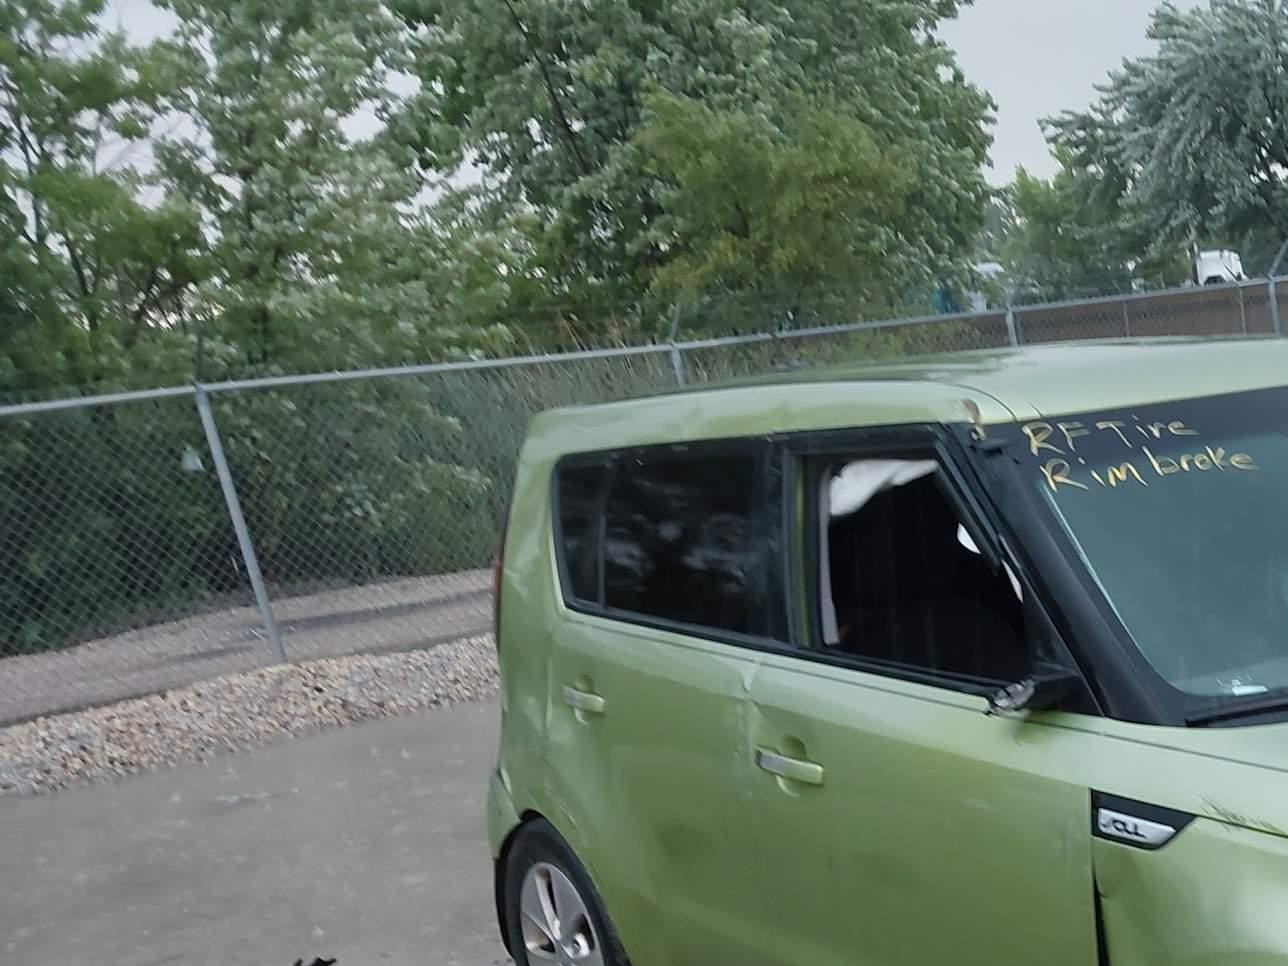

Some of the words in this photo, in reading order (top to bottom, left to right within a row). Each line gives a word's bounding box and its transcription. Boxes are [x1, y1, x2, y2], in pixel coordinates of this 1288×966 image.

[1021, 421, 1091, 456] RF
[1096, 414, 1200, 448] Tire
[1142, 445, 1259, 476] broke
